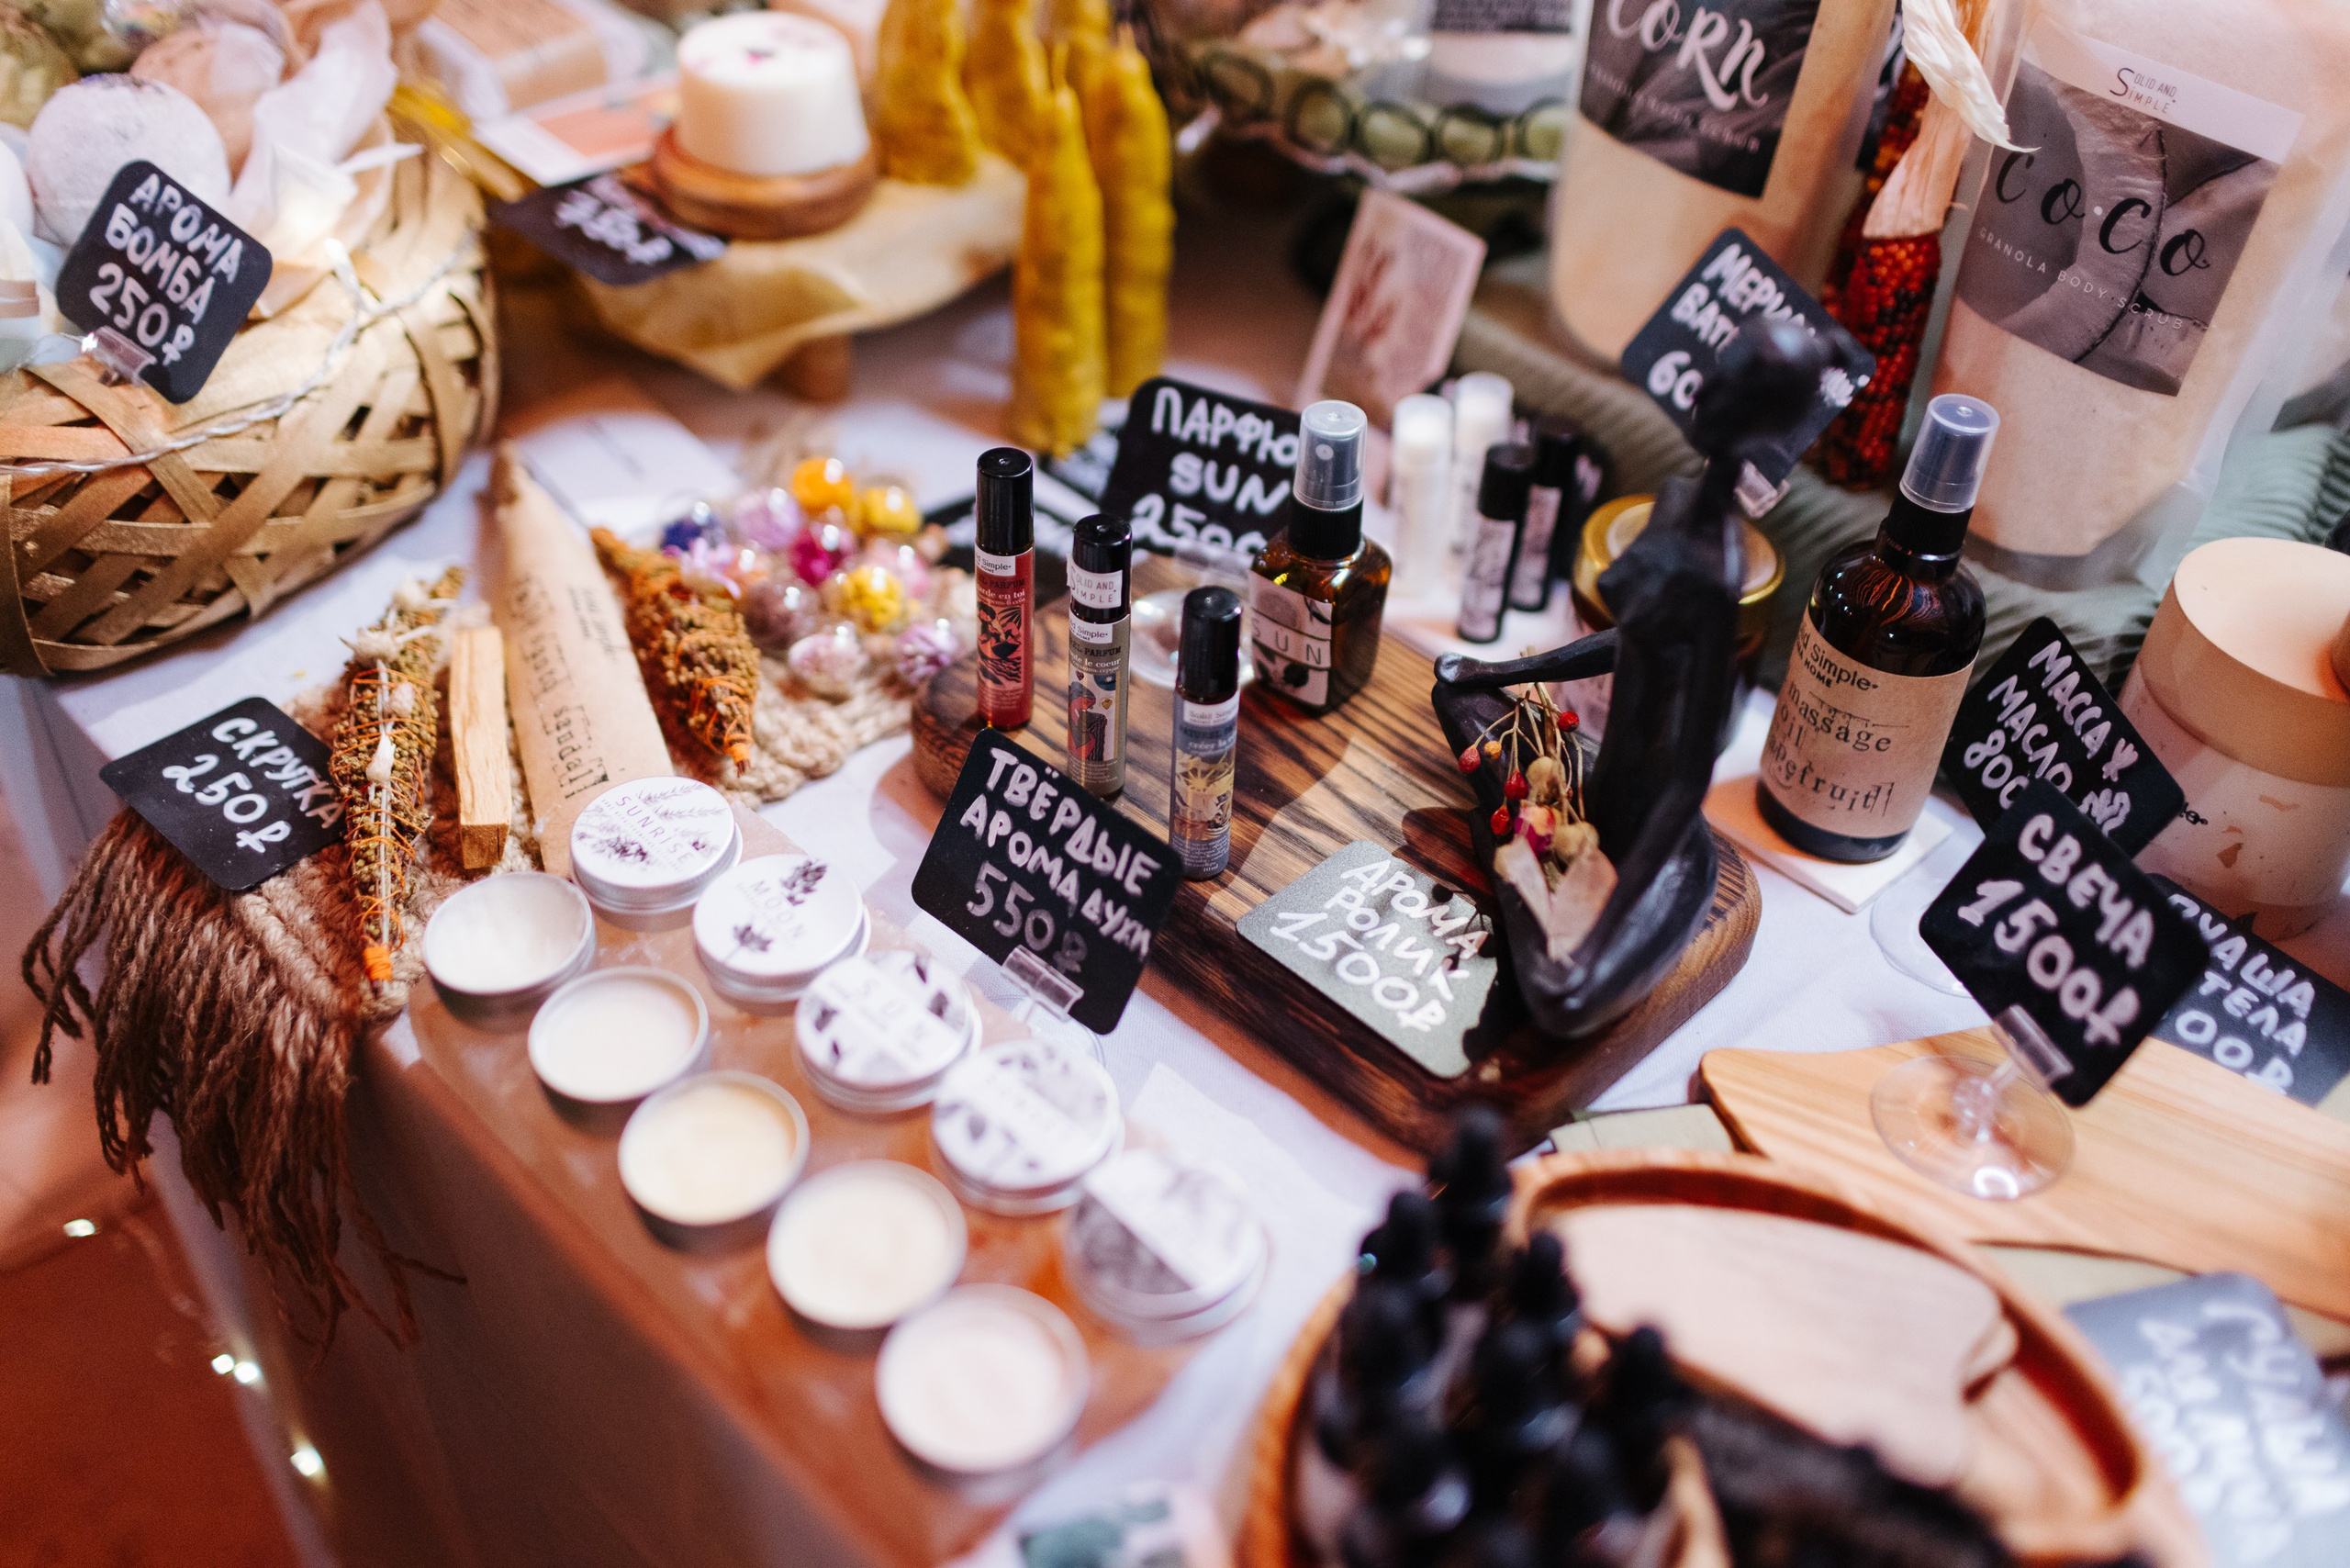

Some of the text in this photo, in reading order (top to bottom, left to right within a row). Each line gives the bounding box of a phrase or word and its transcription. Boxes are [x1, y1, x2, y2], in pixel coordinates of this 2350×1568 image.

[105, 202, 216, 326] БОМБА
[129, 173, 244, 284] АРОМА
[1980, 226, 2184, 330] GRANOLA BODY SCRUB
[1168, 451, 1292, 516] SUN
[990, 578, 1025, 588] PARFUM
[1013, 588, 1025, 599] toi
[1095, 580, 1114, 590] AND
[1084, 646, 1121, 657] PARFUM
[1085, 658, 1093, 666] le
[1096, 658, 1121, 668] coeur
[1251, 618, 1322, 666] SUN
[1804, 657, 1832, 688] HOME
[1781, 703, 1804, 747] oil
[1790, 680, 1892, 752] massage
[1987, 675, 2073, 793] МАСЛО
[211, 717, 345, 829] СКРУТКА
[615, 795, 695, 863] SUNRISE
[987, 746, 1162, 897] ТВЁРДЫЕ
[1340, 859, 1489, 960] АРОМА
[2018, 813, 2155, 970] СВЕЧА
[1324, 885, 1471, 1002] РОЛИК
[2199, 969, 2308, 1057] ТЕЛА
